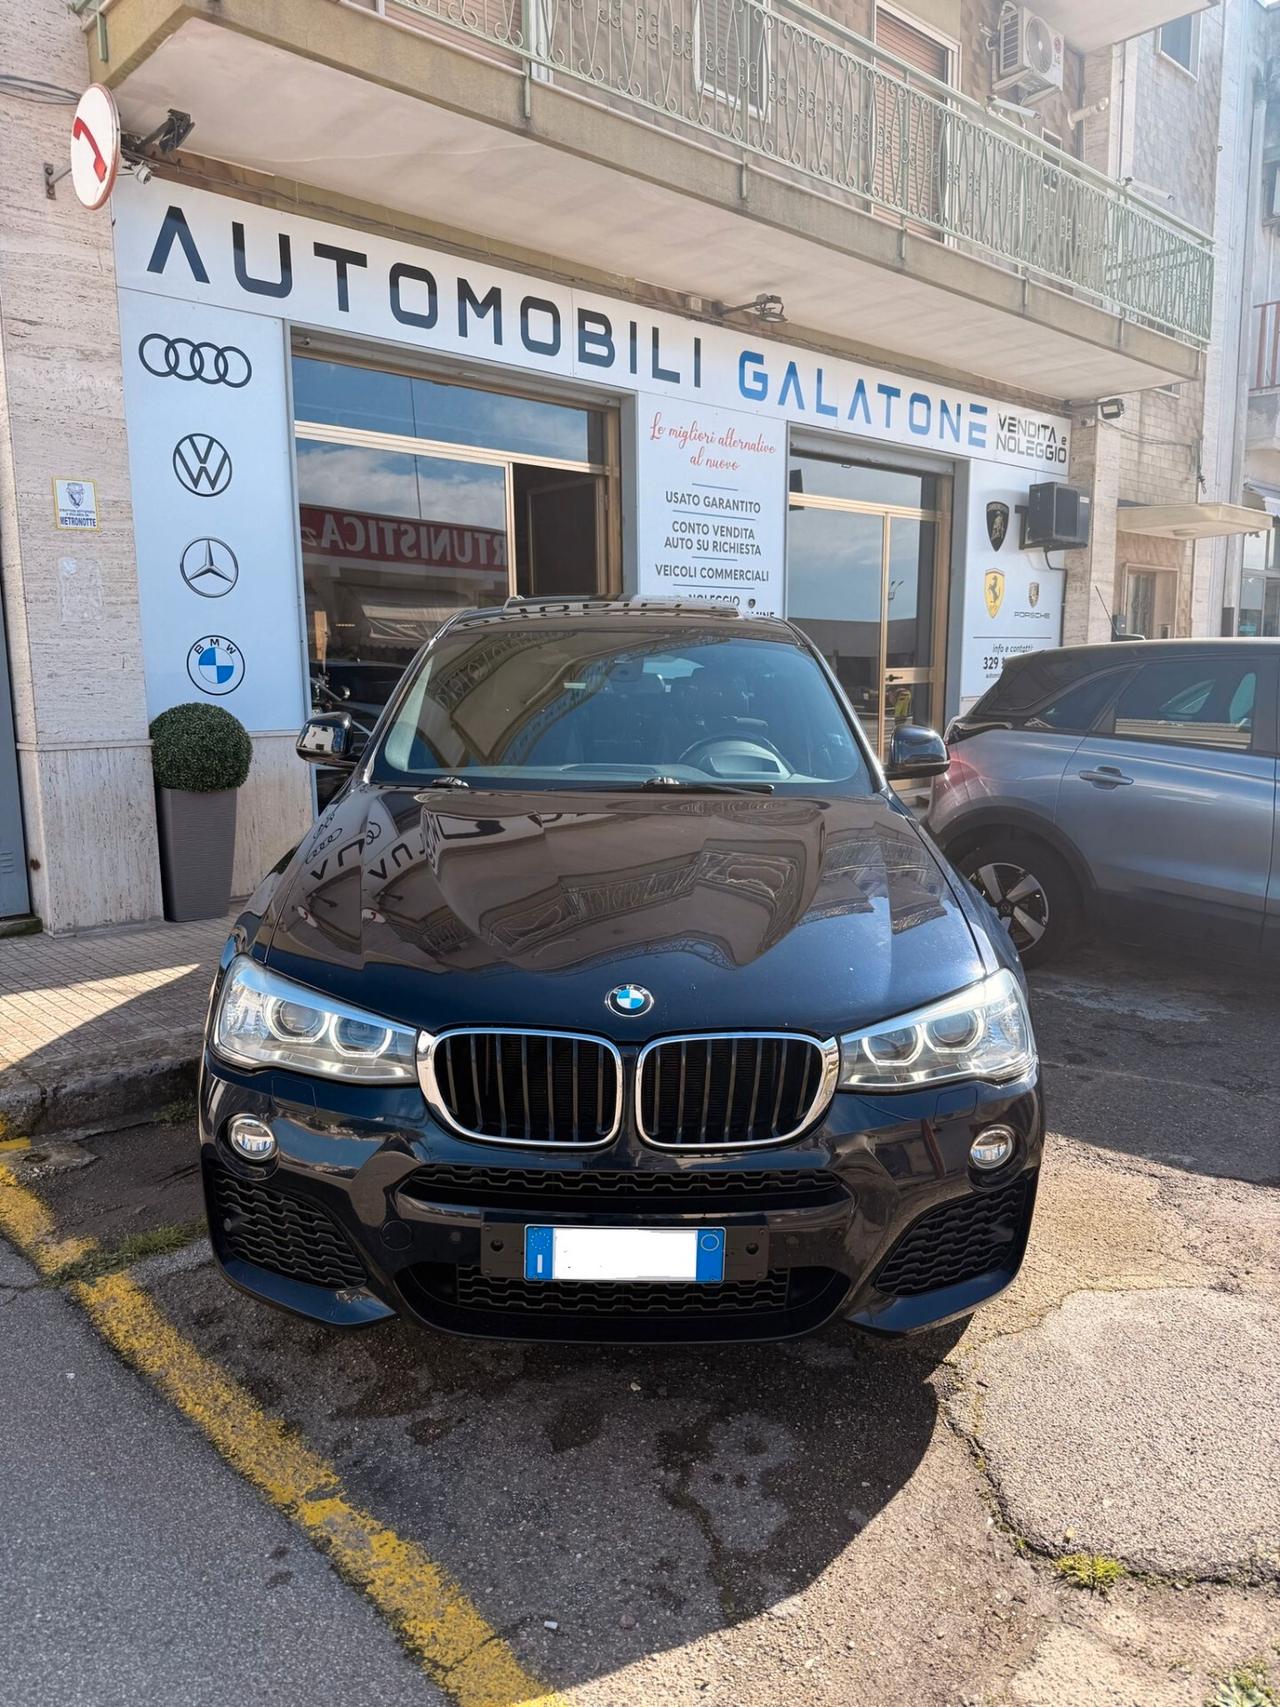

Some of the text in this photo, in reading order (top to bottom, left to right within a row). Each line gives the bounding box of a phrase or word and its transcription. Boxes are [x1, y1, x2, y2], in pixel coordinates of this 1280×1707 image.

[147, 205, 988, 449] AUTOMOBILI GALATONE
[650, 412, 777, 454] Le migliori alternative
[998, 413, 1067, 446] VENDITA e
[690, 446, 741, 470] al nuovo
[996, 432, 1067, 463] NOLEGGIO
[665, 491, 761, 514] USATO GARANTITO
[672, 520, 755, 540] CONTO VENDITA
[664, 536, 762, 556] AUTO SU RICHIESTA
[655, 564, 769, 582] VEICOLI COMMERCIALI
[1014, 611, 1050, 619] PORSCHE
[194, 638, 236, 655] BMW
[983, 656, 999, 670] 329
